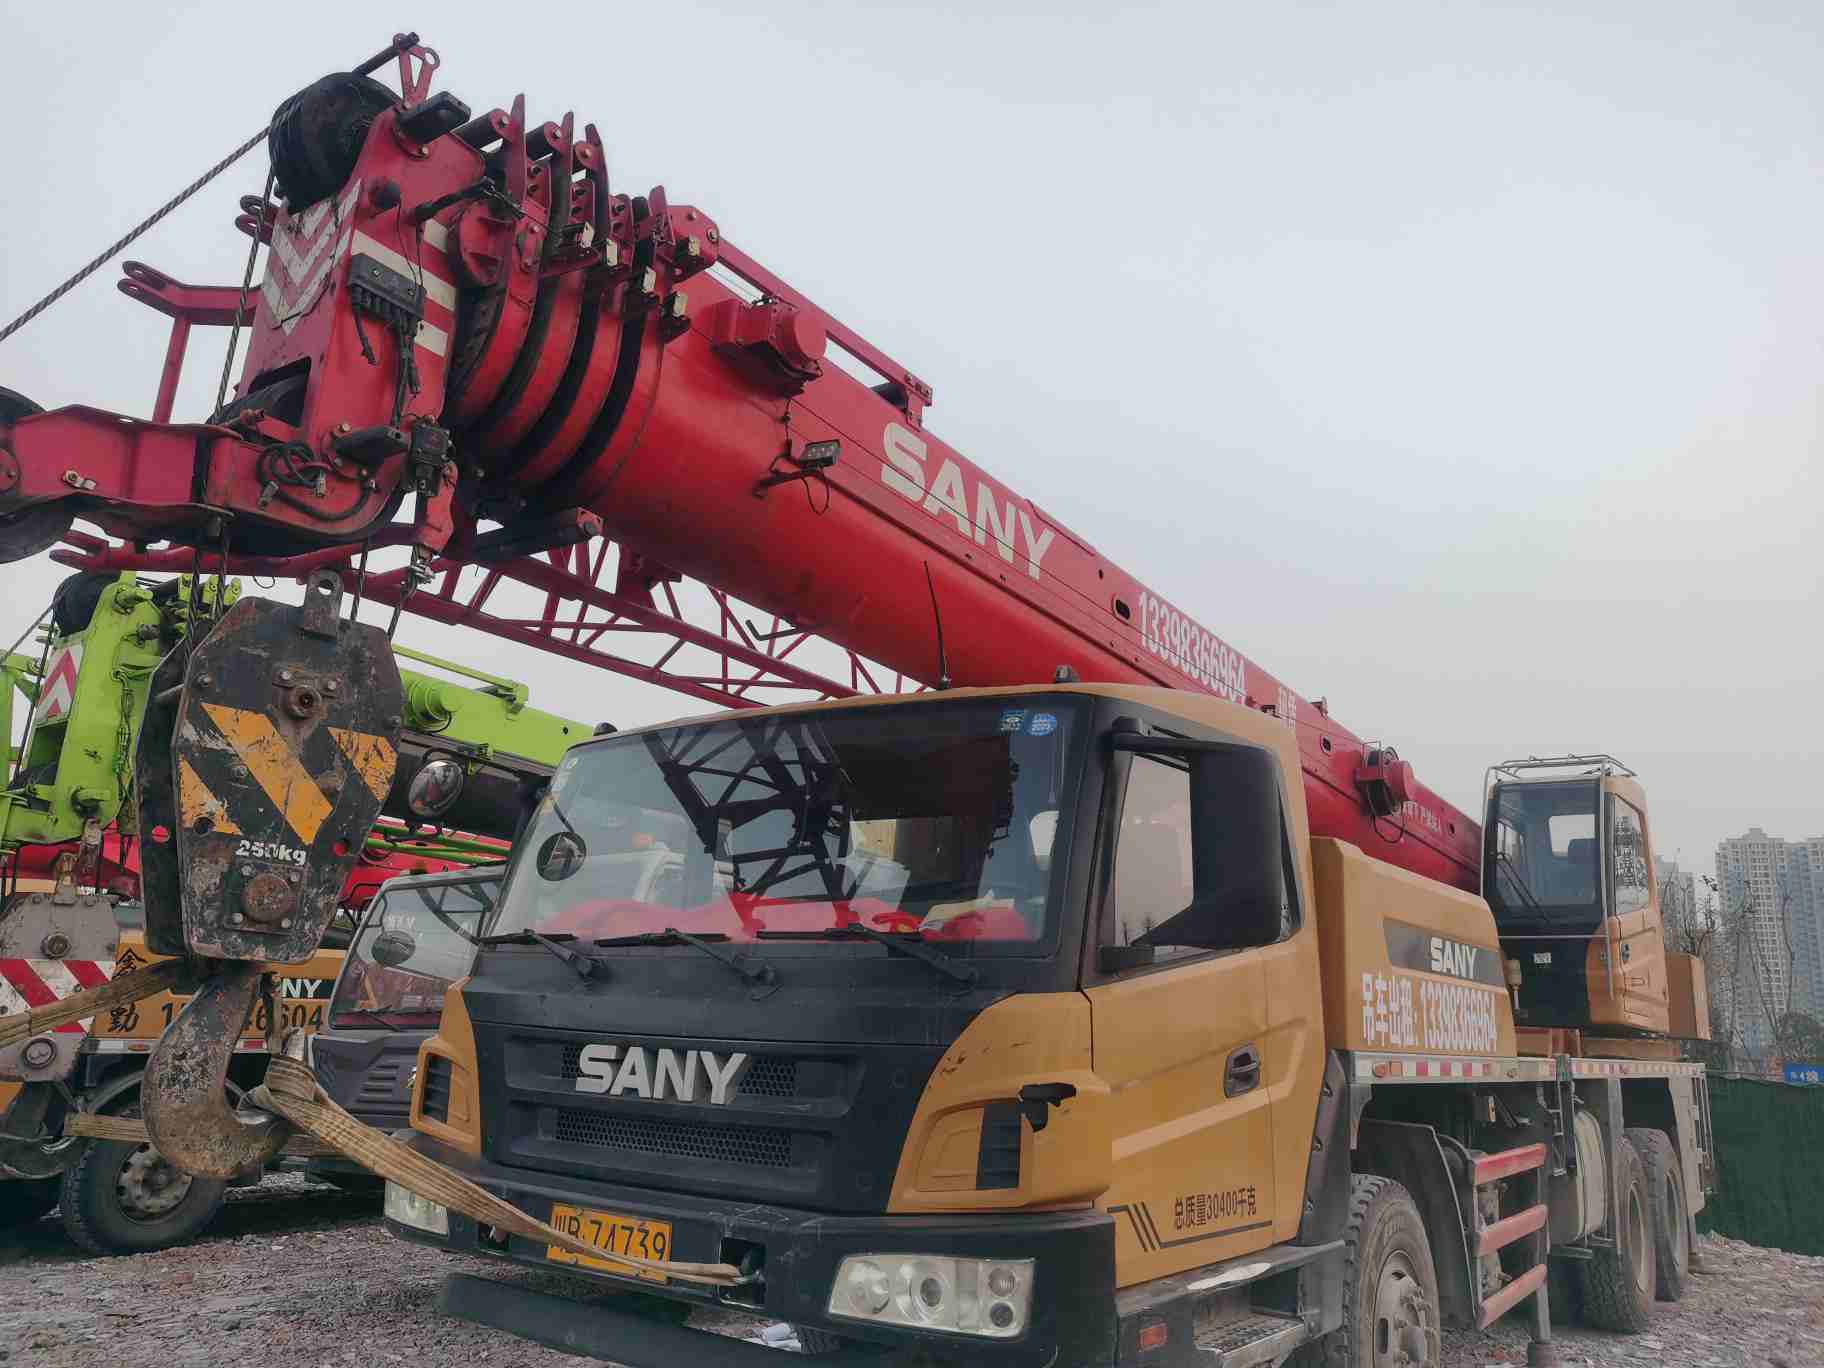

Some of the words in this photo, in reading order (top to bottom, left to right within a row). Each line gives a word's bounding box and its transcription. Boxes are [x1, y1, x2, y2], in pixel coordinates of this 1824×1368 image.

[881, 422, 1053, 580] SANY
[1431, 936, 1477, 980] SANY
[575, 1044, 749, 1105] SANY
